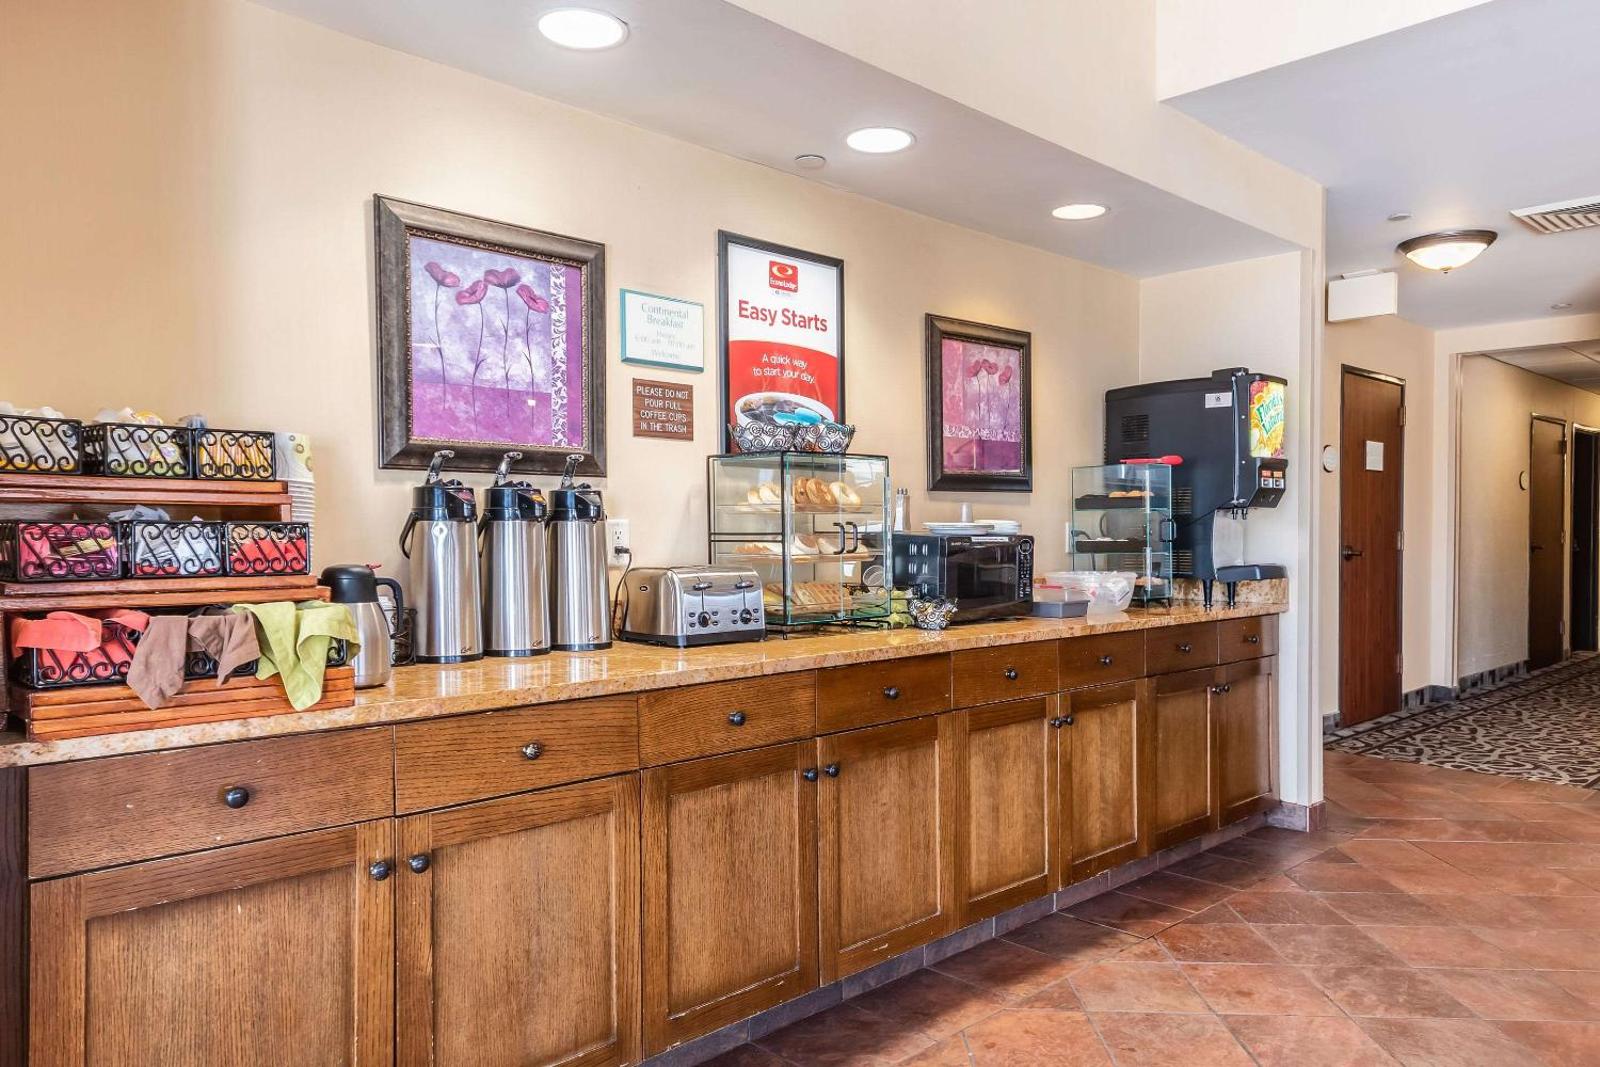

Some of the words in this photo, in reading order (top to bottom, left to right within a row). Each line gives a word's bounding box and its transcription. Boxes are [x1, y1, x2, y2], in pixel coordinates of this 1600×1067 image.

[641, 303, 689, 320] Continental
[738, 299, 778, 327] Easy
[781, 308, 828, 332] Starts
[646, 316, 684, 329] Breakfast
[762, 353, 769, 363] A
[770, 353, 791, 367] quick
[792, 358, 808, 369] way
[752, 367, 761, 376] to
[763, 366, 781, 378] start
[782, 370, 799, 381] your
[636, 385, 663, 397] PLEASE
[665, 388, 674, 398] DO
[675, 390, 689, 399] NOT
[644, 398, 664, 409] POUR
[665, 400, 682, 411] FULL
[640, 409, 667, 420] COFFEE
[668, 412, 687, 422] CUPS
[640, 421, 648, 431] IN
[649, 422, 664, 432] THE
[665, 423, 687, 434] TRASH
